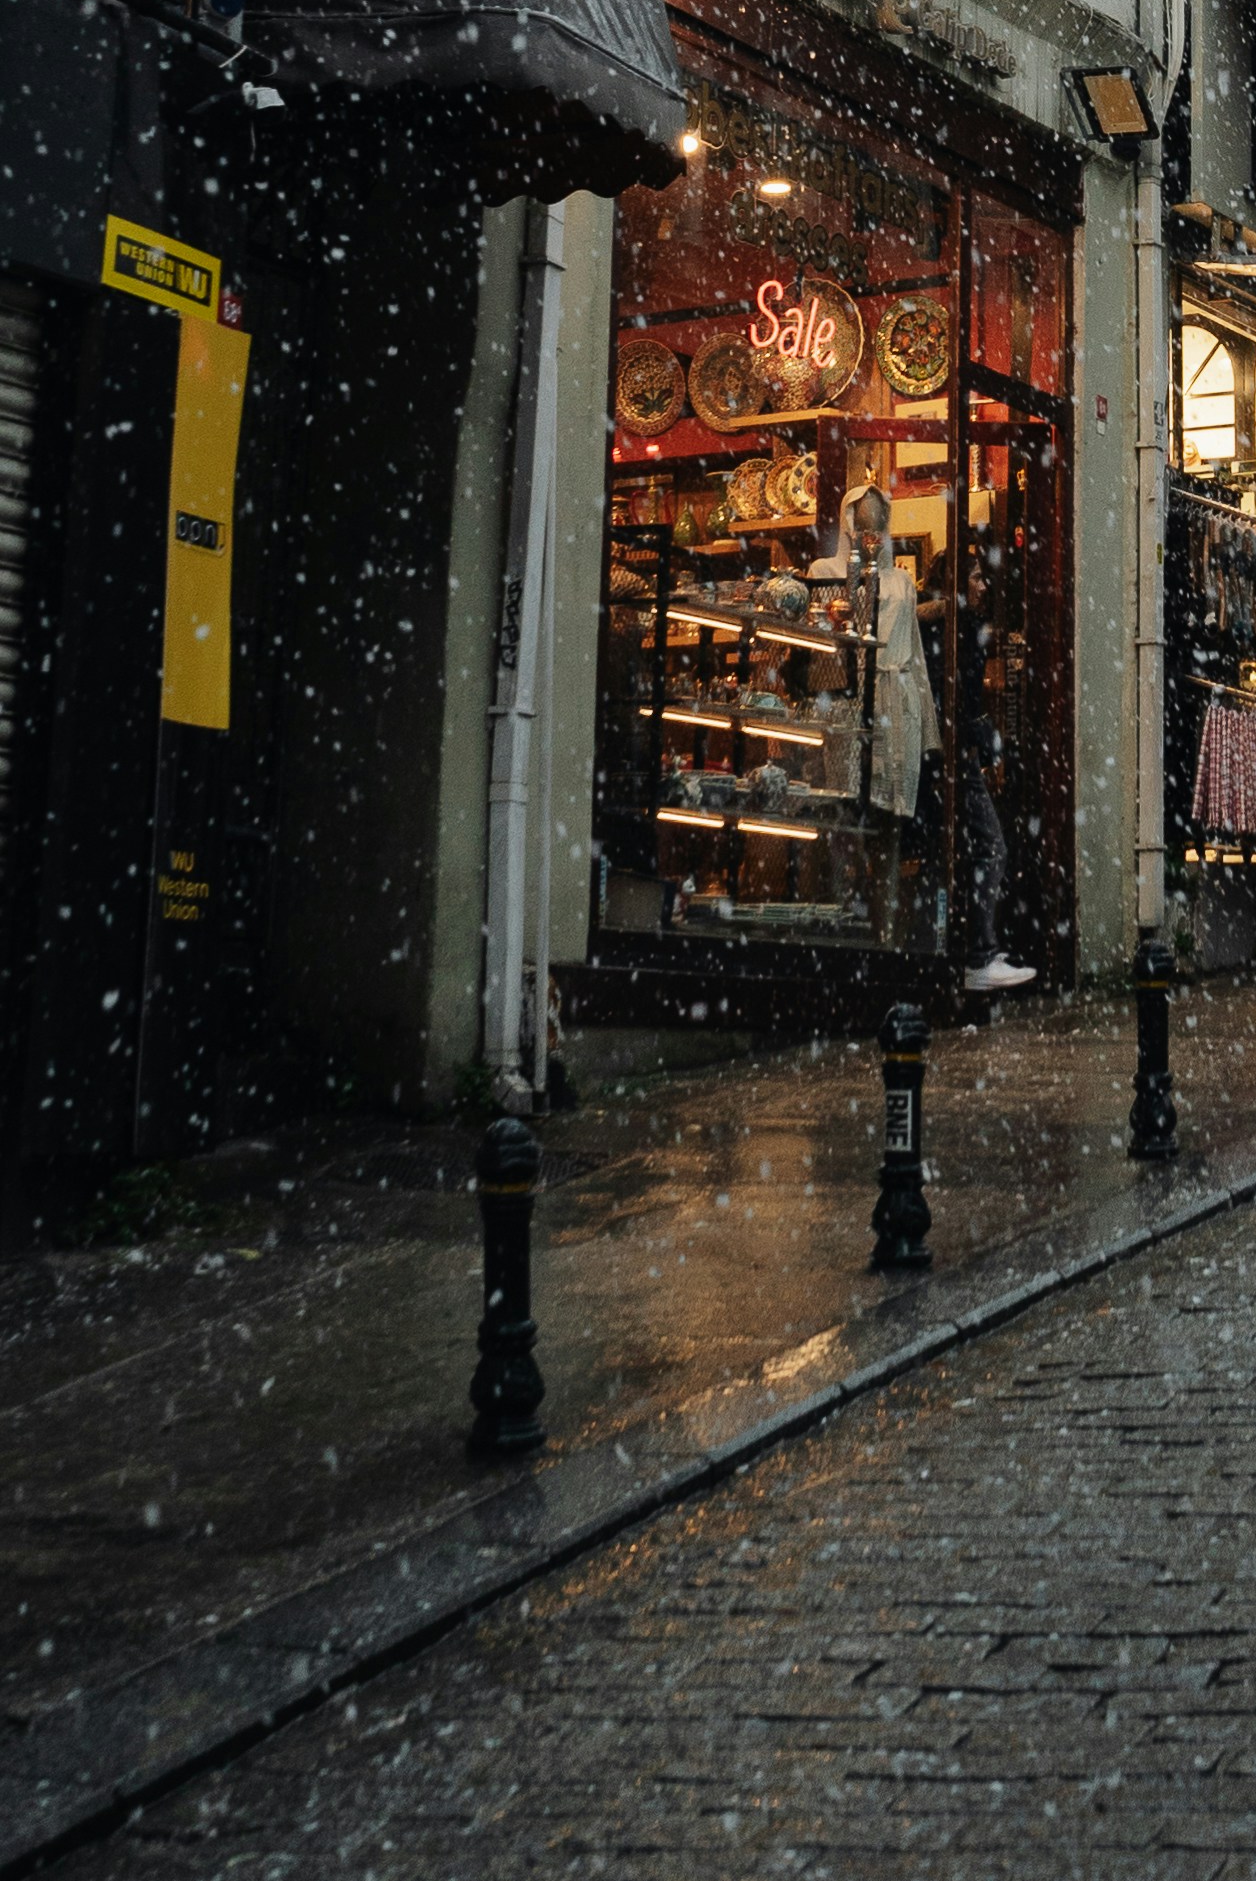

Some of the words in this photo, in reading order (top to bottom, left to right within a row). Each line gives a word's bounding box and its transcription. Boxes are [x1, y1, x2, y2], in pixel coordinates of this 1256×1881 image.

[119, 241, 175, 273] WESTERN
[136, 262, 175, 287] UNION
[749, 279, 837, 369] Sale
[169, 849, 195, 873] WU
[158, 874, 210, 898] Western
[163, 898, 200, 921] Union
